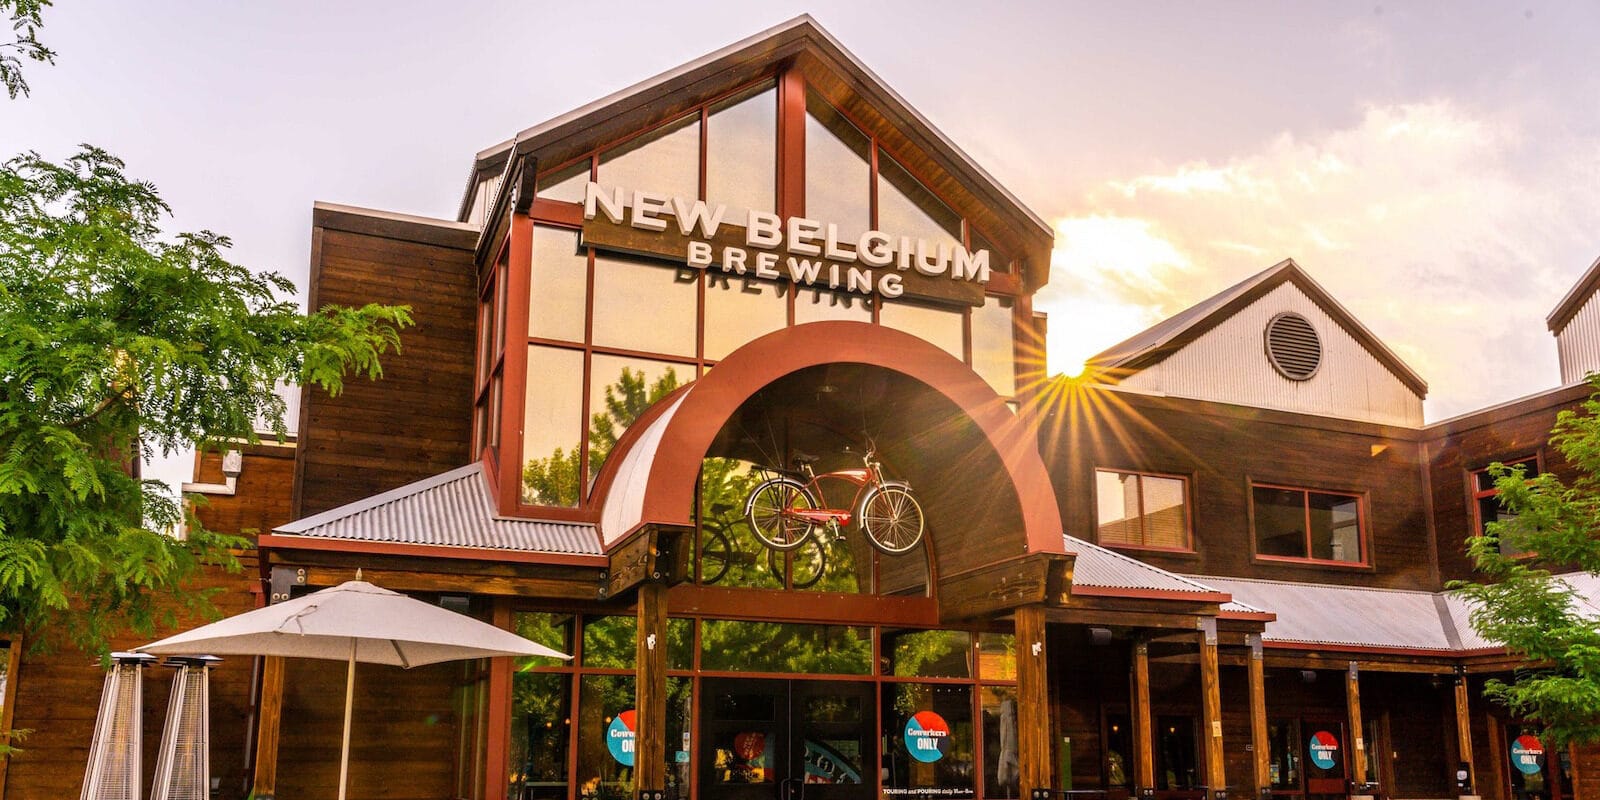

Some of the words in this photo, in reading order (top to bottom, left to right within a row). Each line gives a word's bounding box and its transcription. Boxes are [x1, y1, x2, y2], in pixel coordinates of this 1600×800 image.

[583, 182, 725, 238] NEW
[746, 209, 991, 283] BELGIUM
[687, 241, 904, 298] BREWING
[908, 728, 946, 736] Coworkers
[917, 738, 938, 750] ONLY
[1317, 751, 1332, 760] ONLY
[1520, 755, 1537, 764] ONLY
